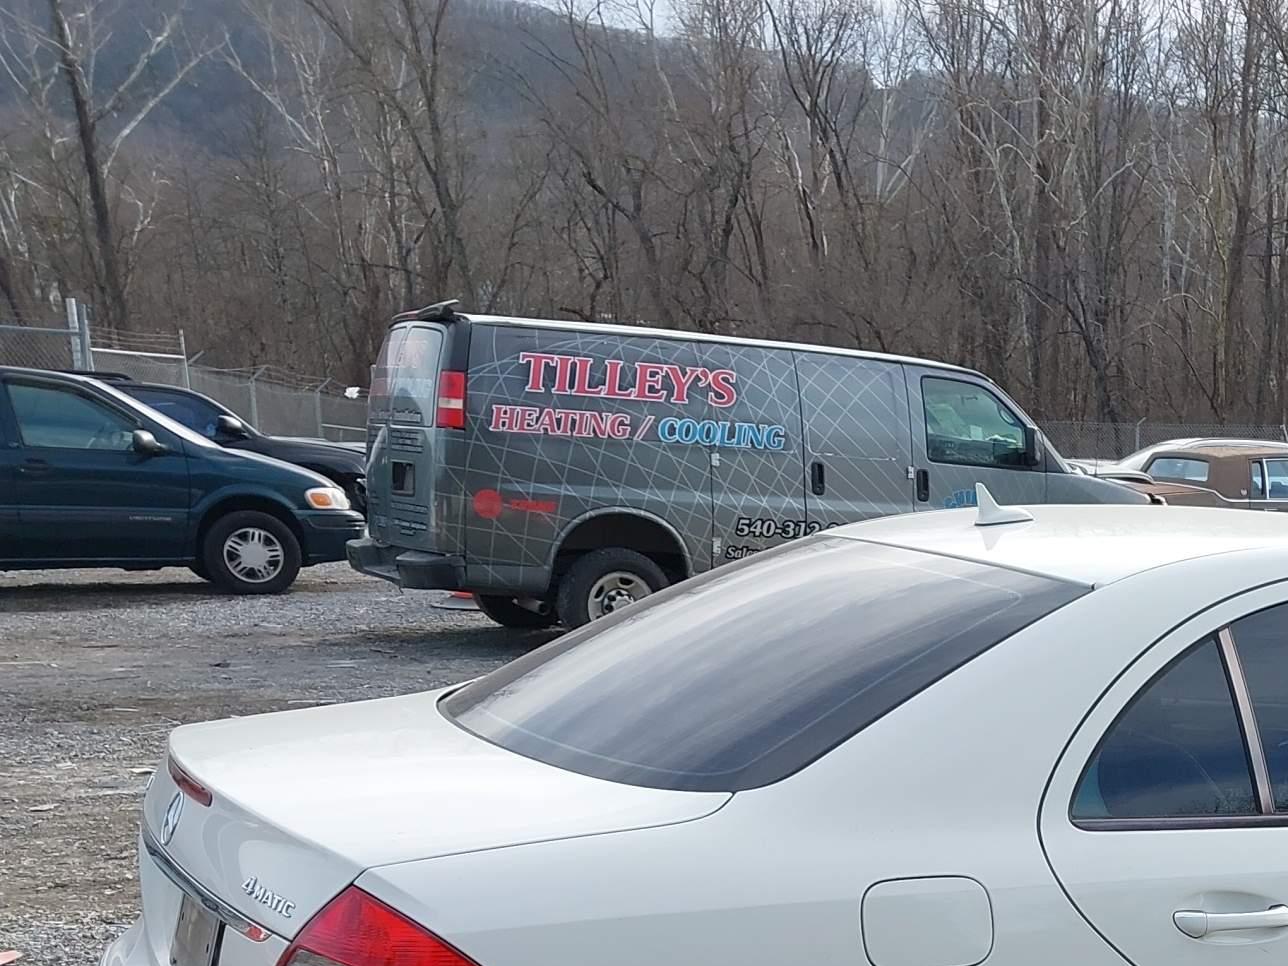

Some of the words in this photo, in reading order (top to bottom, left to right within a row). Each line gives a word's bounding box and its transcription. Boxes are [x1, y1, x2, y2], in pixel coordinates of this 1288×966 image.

[520, 352, 737, 407] TILLEY'S
[490, 405, 631, 439] HEATING
[633, 416, 654, 440] /
[658, 417, 785, 450] COOLING
[241, 876, 296, 918] 4MATIC
